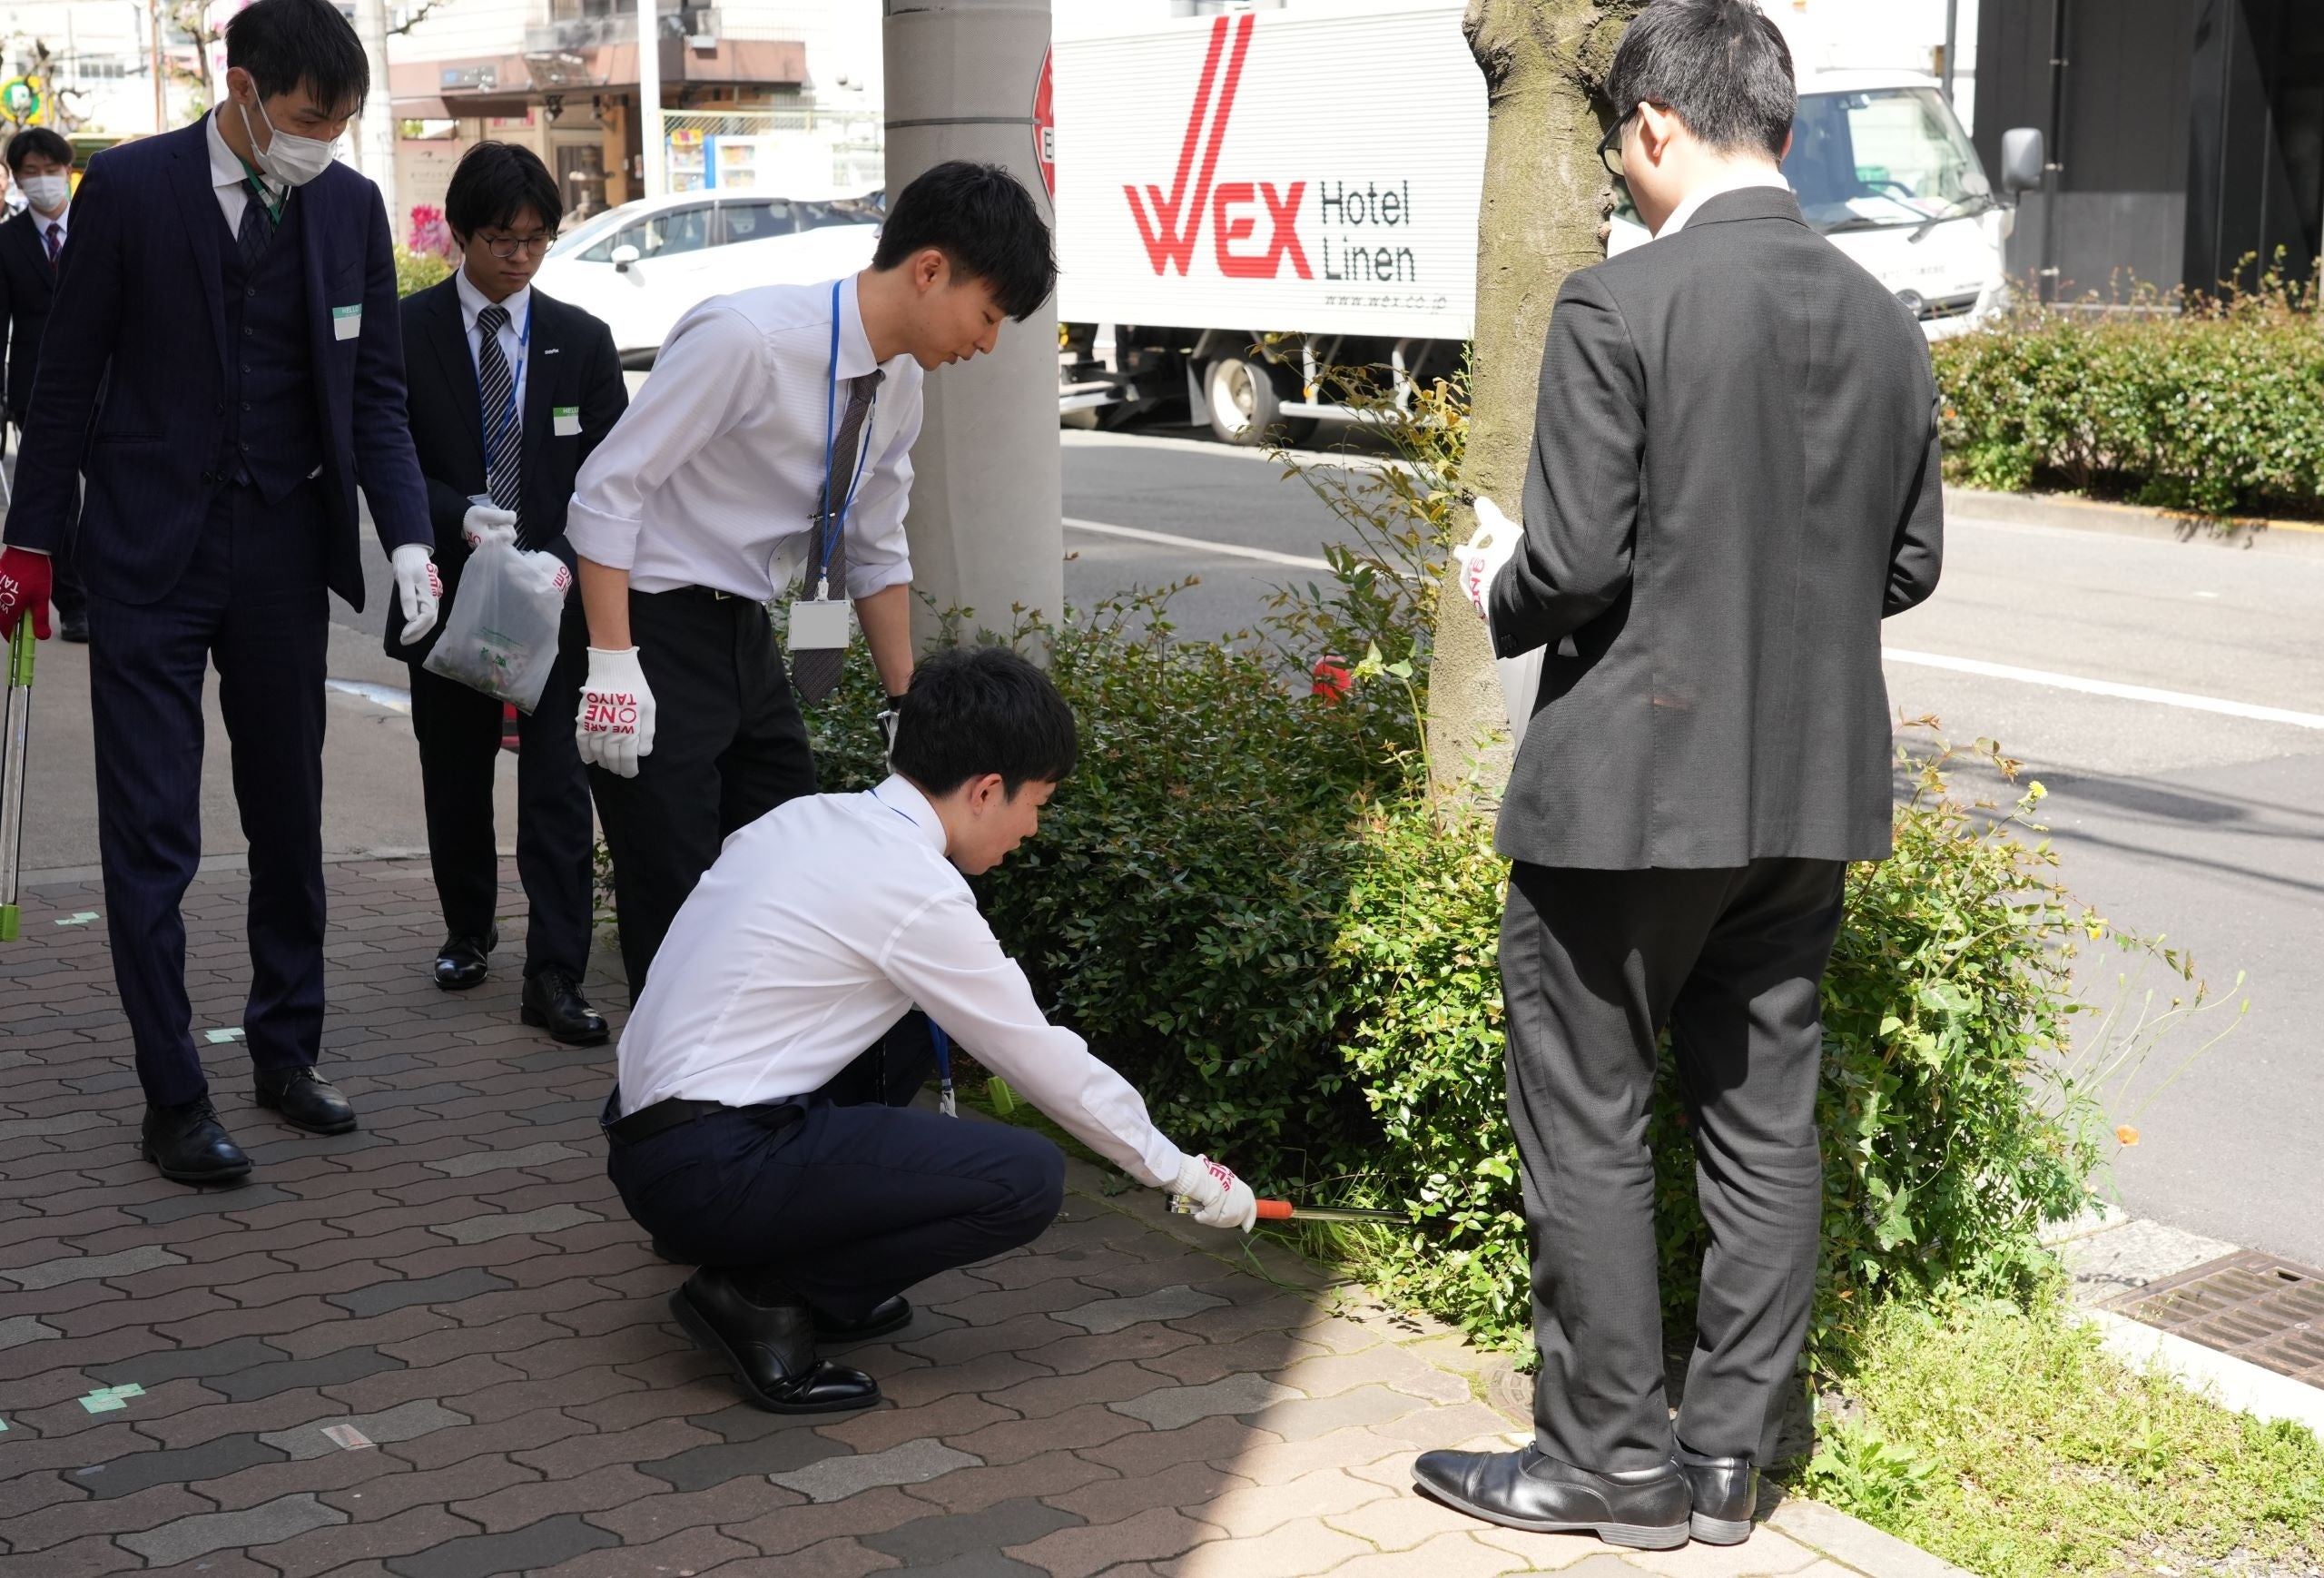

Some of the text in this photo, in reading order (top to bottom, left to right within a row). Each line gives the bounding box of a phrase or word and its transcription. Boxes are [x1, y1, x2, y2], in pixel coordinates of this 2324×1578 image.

[1123, 14, 1315, 280] WEX
[1321, 180, 1409, 225] Hotel
[1324, 235, 1415, 281] Linen
[1325, 294, 1448, 314] www.wex.co.jp
[586, 693, 637, 705] TAIYO
[585, 705, 636, 724] ONE
[584, 722, 635, 734] WE ARE
